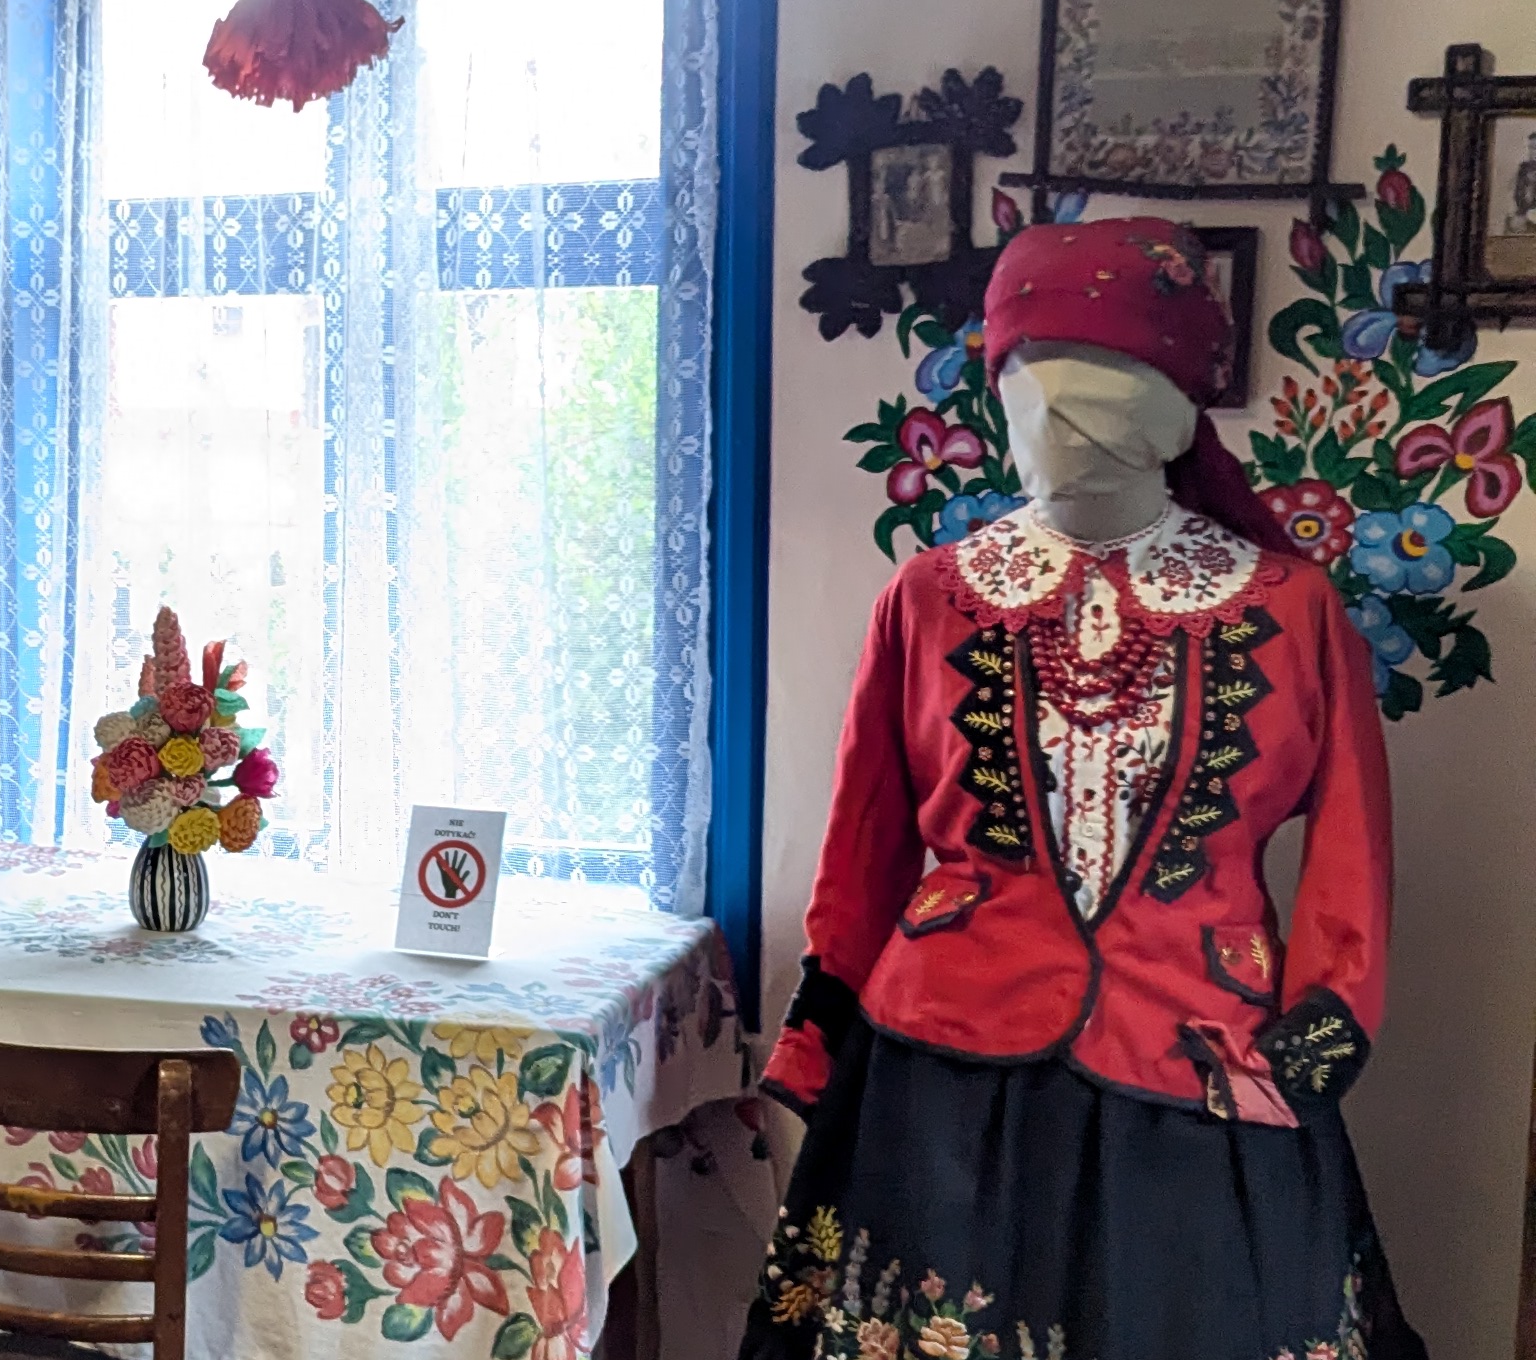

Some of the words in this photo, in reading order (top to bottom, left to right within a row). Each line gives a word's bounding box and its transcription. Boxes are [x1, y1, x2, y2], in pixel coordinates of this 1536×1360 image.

[449, 819, 464, 827] NIE
[433, 910, 459, 920] DON'T
[428, 922, 460, 932] TOUCH!
